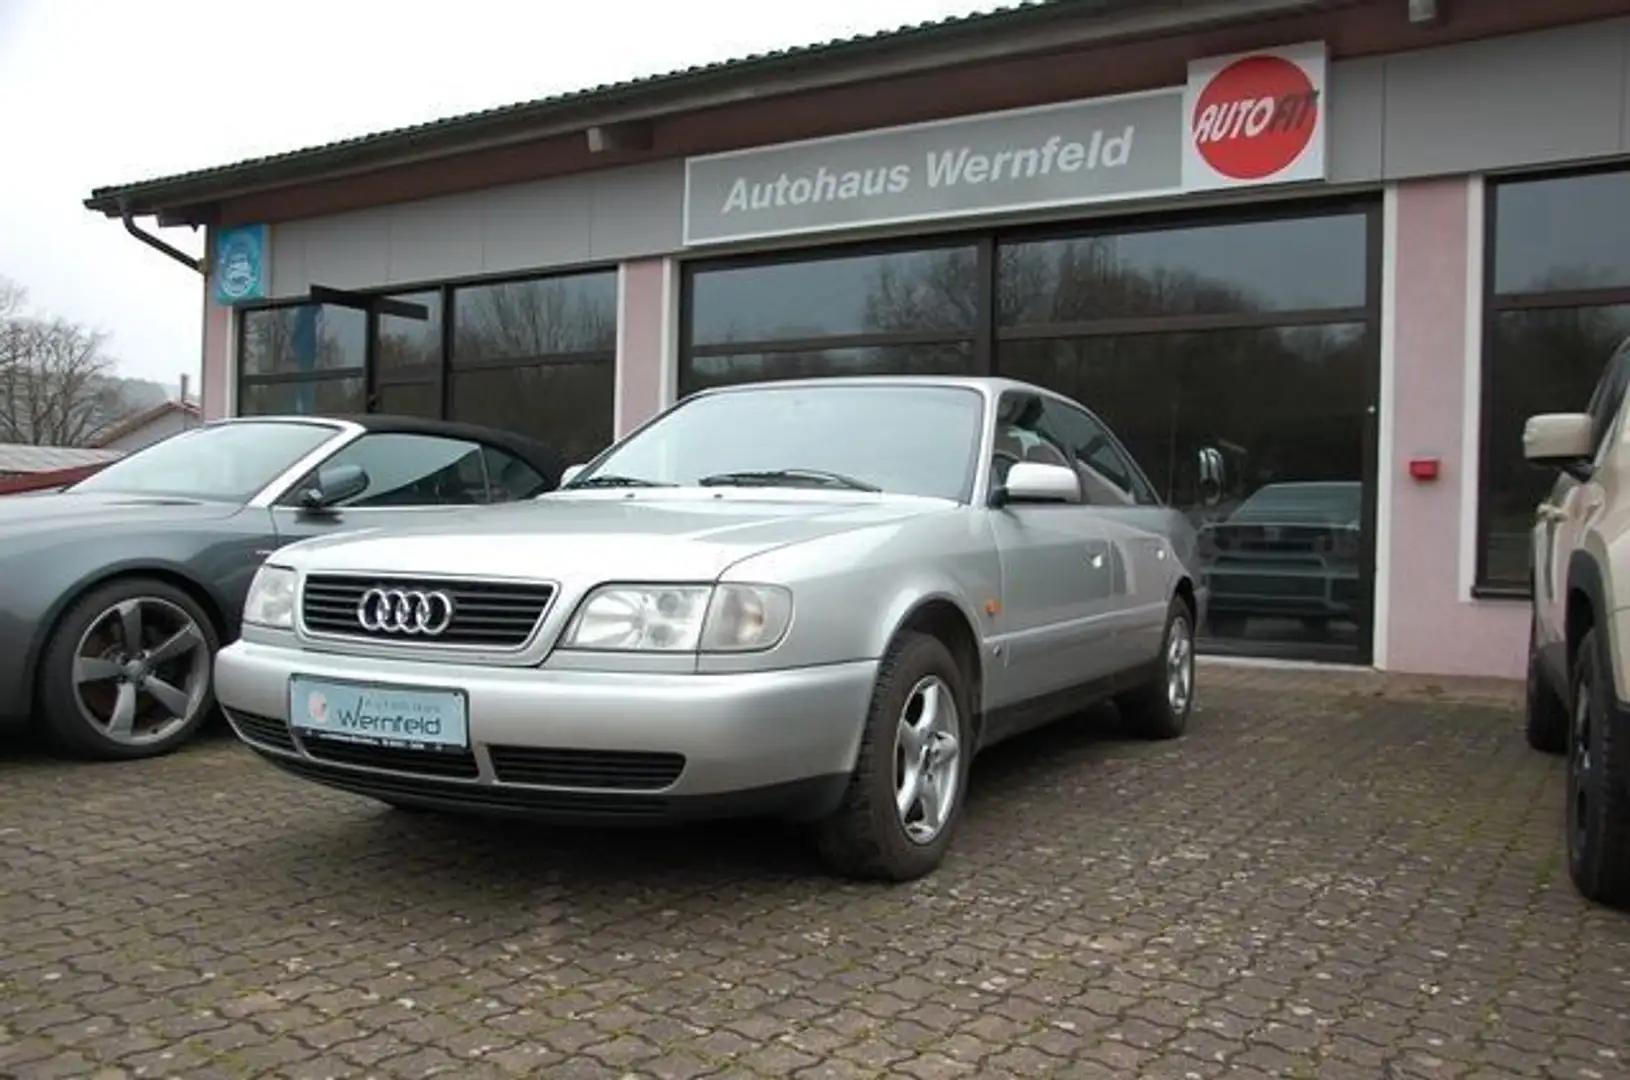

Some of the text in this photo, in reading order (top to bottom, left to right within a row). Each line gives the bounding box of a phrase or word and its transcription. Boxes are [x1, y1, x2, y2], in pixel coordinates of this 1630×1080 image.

[721, 126, 1136, 216] Autohaus Wernfeld
[337, 696, 442, 735] Wernfeld
